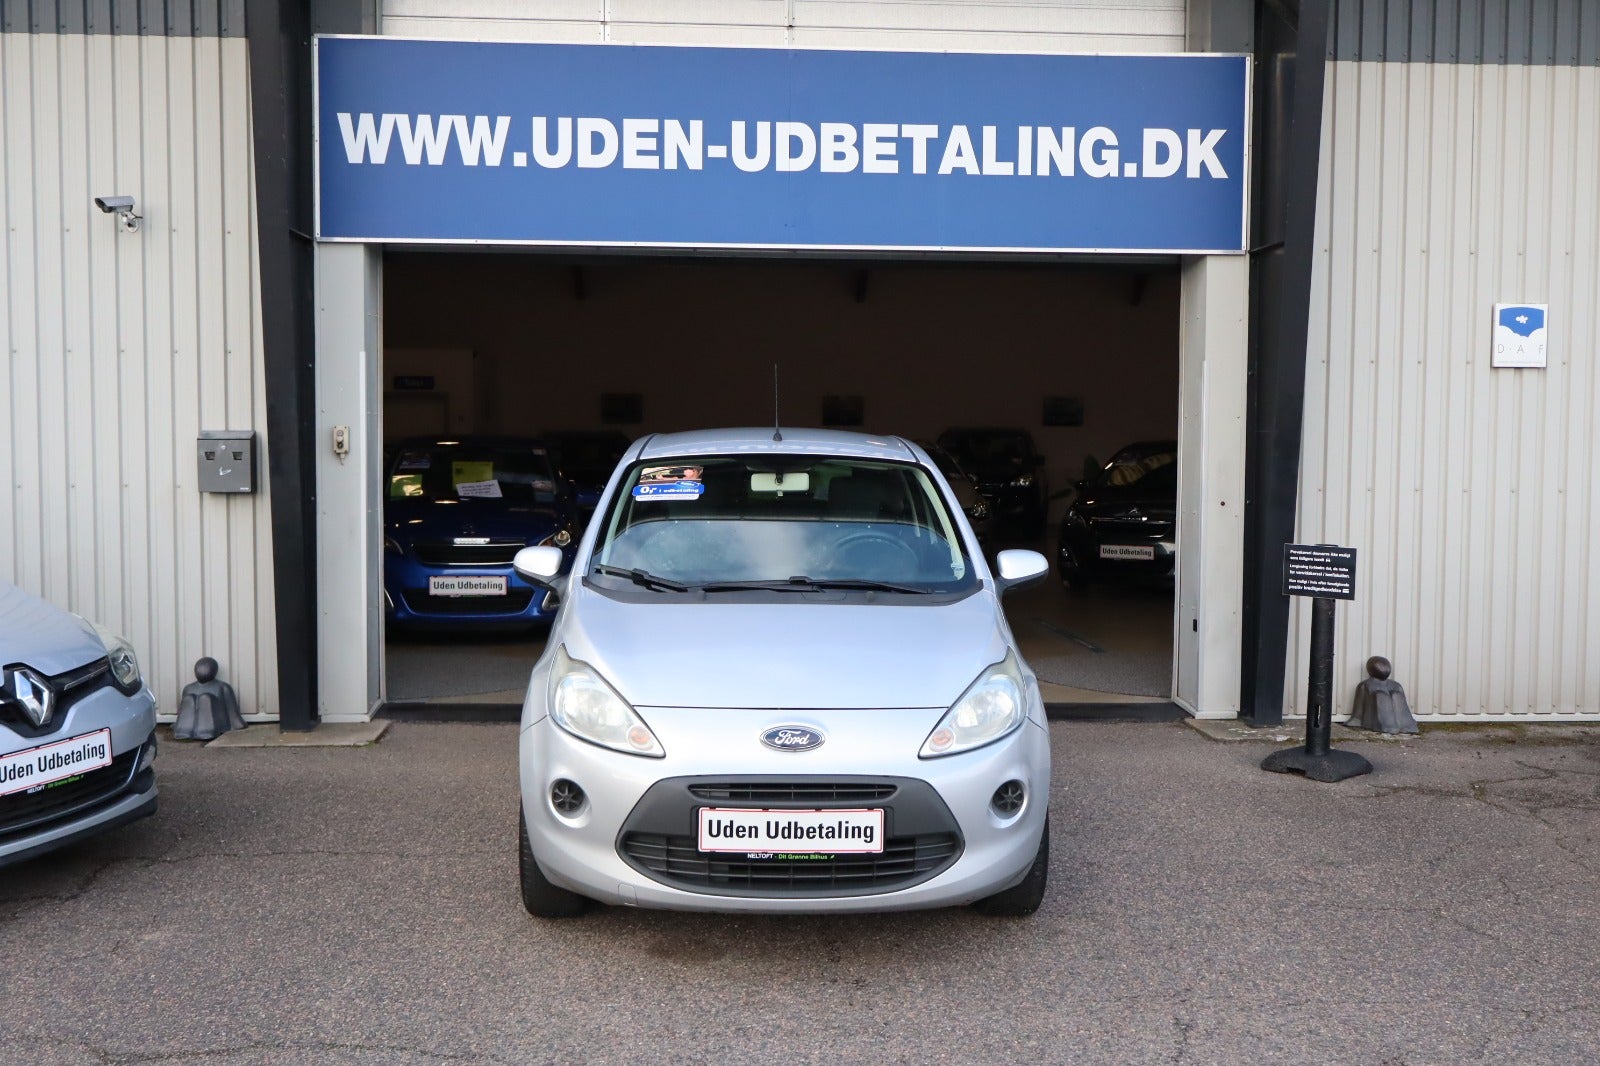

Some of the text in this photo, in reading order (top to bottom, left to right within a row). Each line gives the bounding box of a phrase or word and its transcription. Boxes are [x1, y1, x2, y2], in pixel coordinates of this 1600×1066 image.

[336, 112, 1229, 179] WWW.UDEN-UDBETALING.DK
[1119, 548, 1152, 557] Udbetaling
[433, 581, 503, 591] Uden Udbetaling
[774, 729, 810, 744] Ford
[38, 744, 105, 772] Udbetaling
[708, 819, 874, 844] Uden Udbetaling
